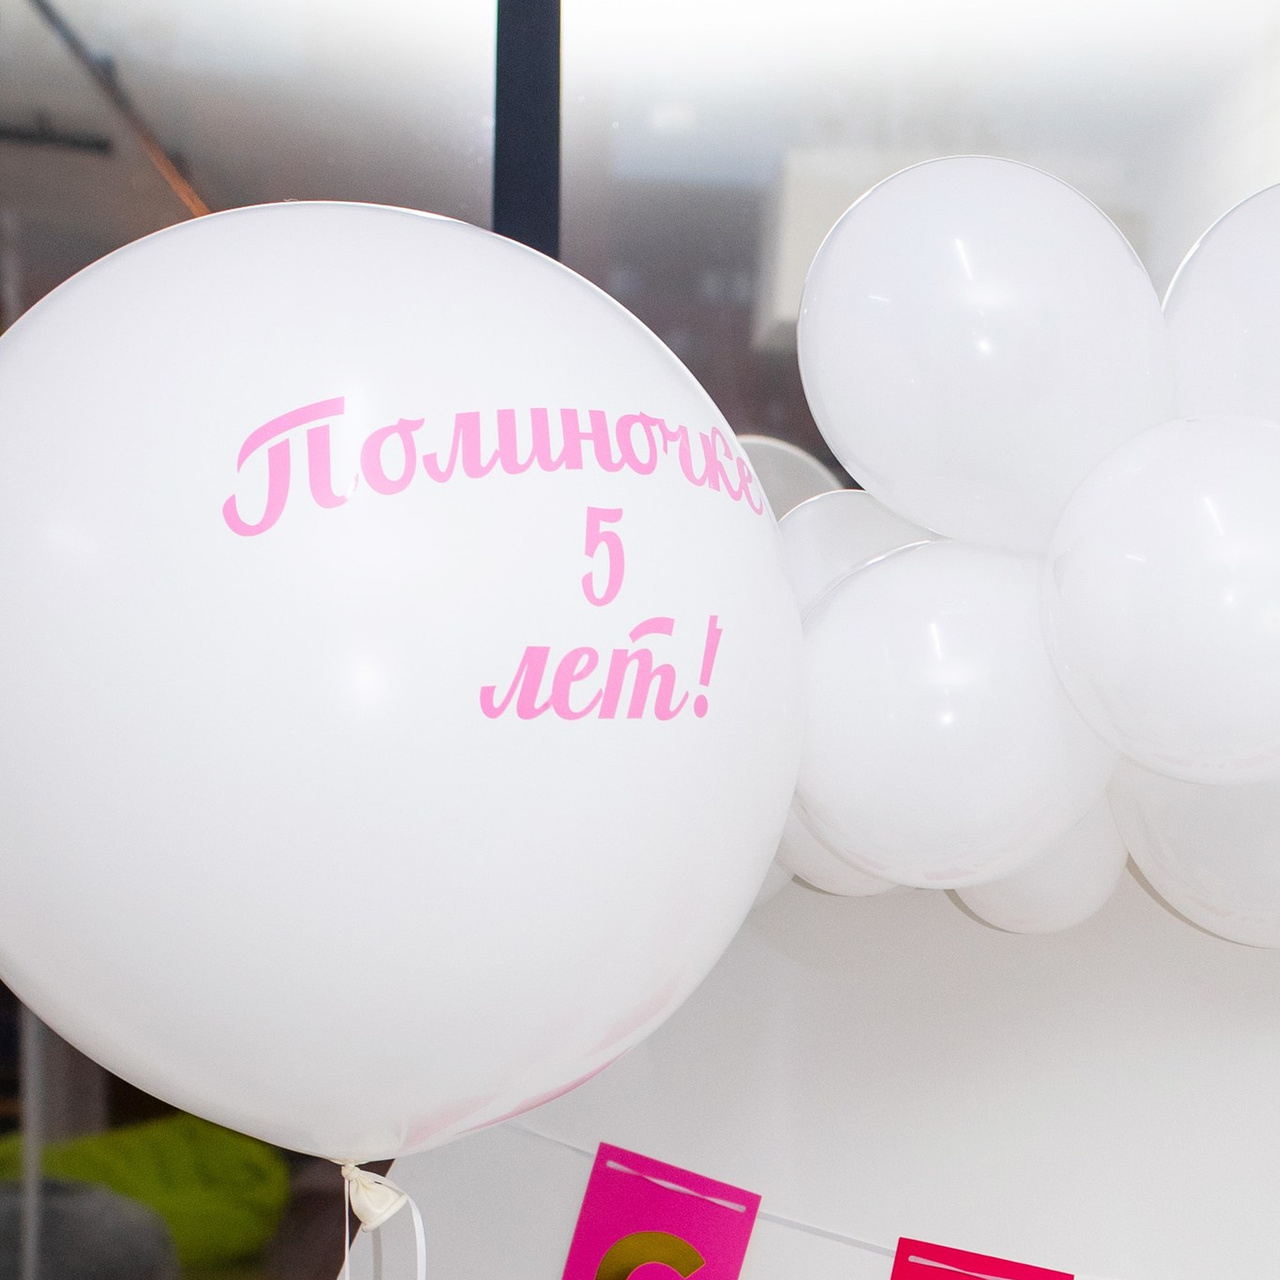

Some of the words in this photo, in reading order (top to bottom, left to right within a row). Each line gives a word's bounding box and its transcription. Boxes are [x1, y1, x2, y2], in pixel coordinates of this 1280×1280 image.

[222, 396, 763, 537] Полиночке
[581, 506, 625, 607] 5
[479, 614, 723, 721] лет!
